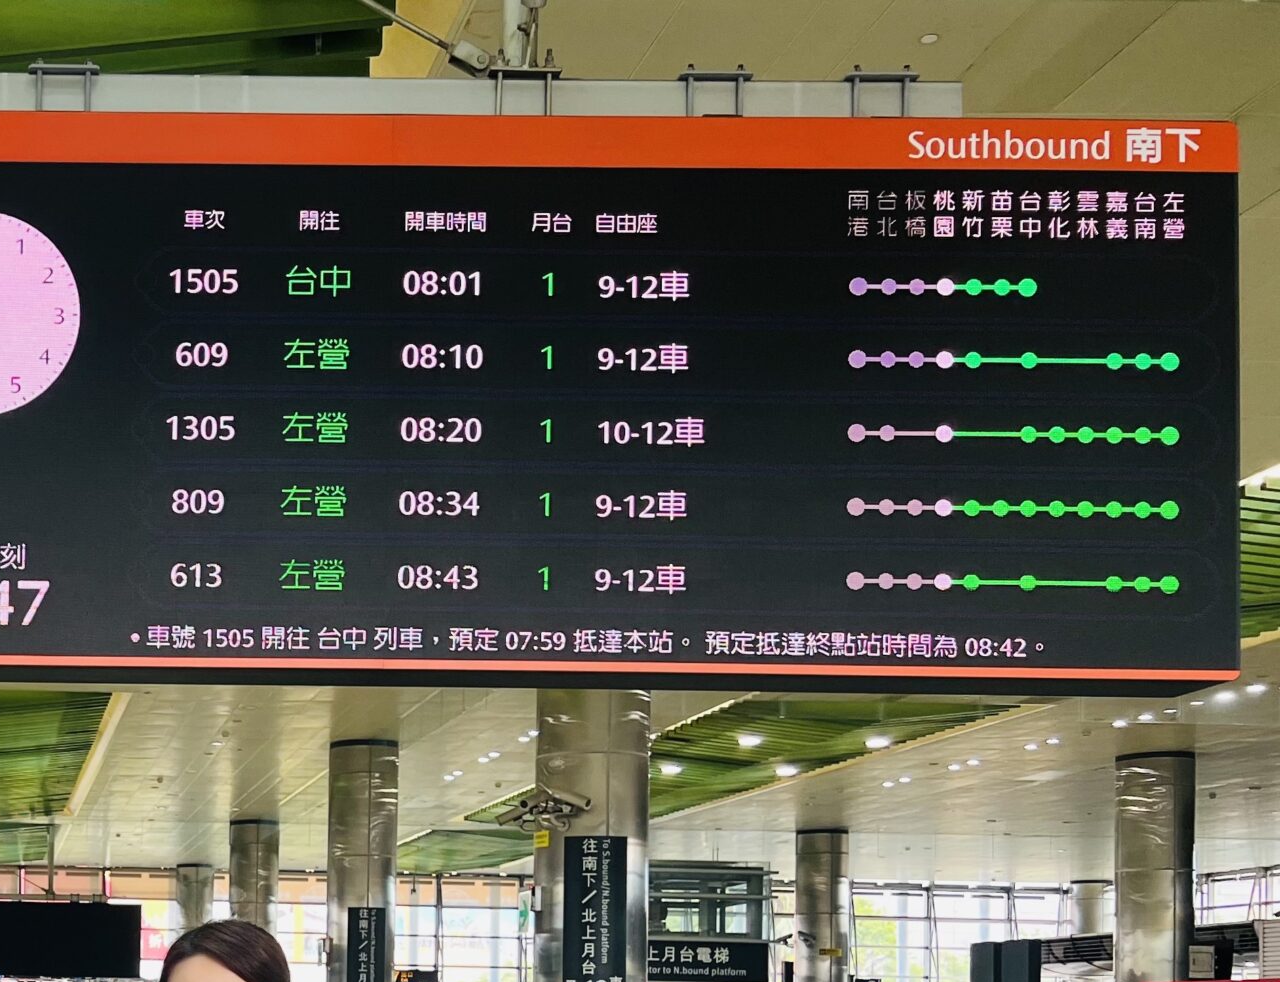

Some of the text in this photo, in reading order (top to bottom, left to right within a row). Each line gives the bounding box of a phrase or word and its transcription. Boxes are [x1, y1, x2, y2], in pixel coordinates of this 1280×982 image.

[909, 128, 1200, 163] Southbound 南下
[184, 210, 657, 233] 車次 開往 開車時間 月台 自由座
[933, 190, 955, 237] 桃園
[962, 190, 985, 237] 新竹
[991, 190, 1013, 238] 苗栗
[1019, 191, 1041, 238] 台中
[1048, 191, 1070, 238] 彰化
[1077, 191, 1099, 238] 雲林
[1106, 191, 1128, 239] 嘉義
[1134, 192, 1156, 239] 台南
[1163, 192, 1184, 238] 左營
[17, 239, 23, 254] 1
[43, 268, 53, 283] 2
[170, 265, 689, 301] 1505 台中 08:01 1 9-12車
[55, 308, 64, 324] 3
[40, 349, 49, 364] 4
[176, 339, 688, 373] 609 左營 08:10 1 9-12車
[11, 377, 21, 393] 5
[167, 412, 704, 447] 1305 左營 08:20 1 10-12車
[172, 486, 687, 520] 809 左營 08:34 1 9-12車
[171, 559, 686, 594] 613 左營 08:43 1 9-12車
[147, 625, 195, 648] 車號
[203, 629, 254, 647] 1505
[262, 627, 310, 649] 開往
[318, 627, 366, 650] 台中
[506, 632, 566, 650] 07:59
[705, 631, 957, 658] 預定抵達終點站時間為
[602, 838, 611, 849] To
[600, 927, 609, 964] platform
[663, 966, 671, 974] to
[673, 966, 709, 975] N.bound
[711, 968, 747, 977] platform
